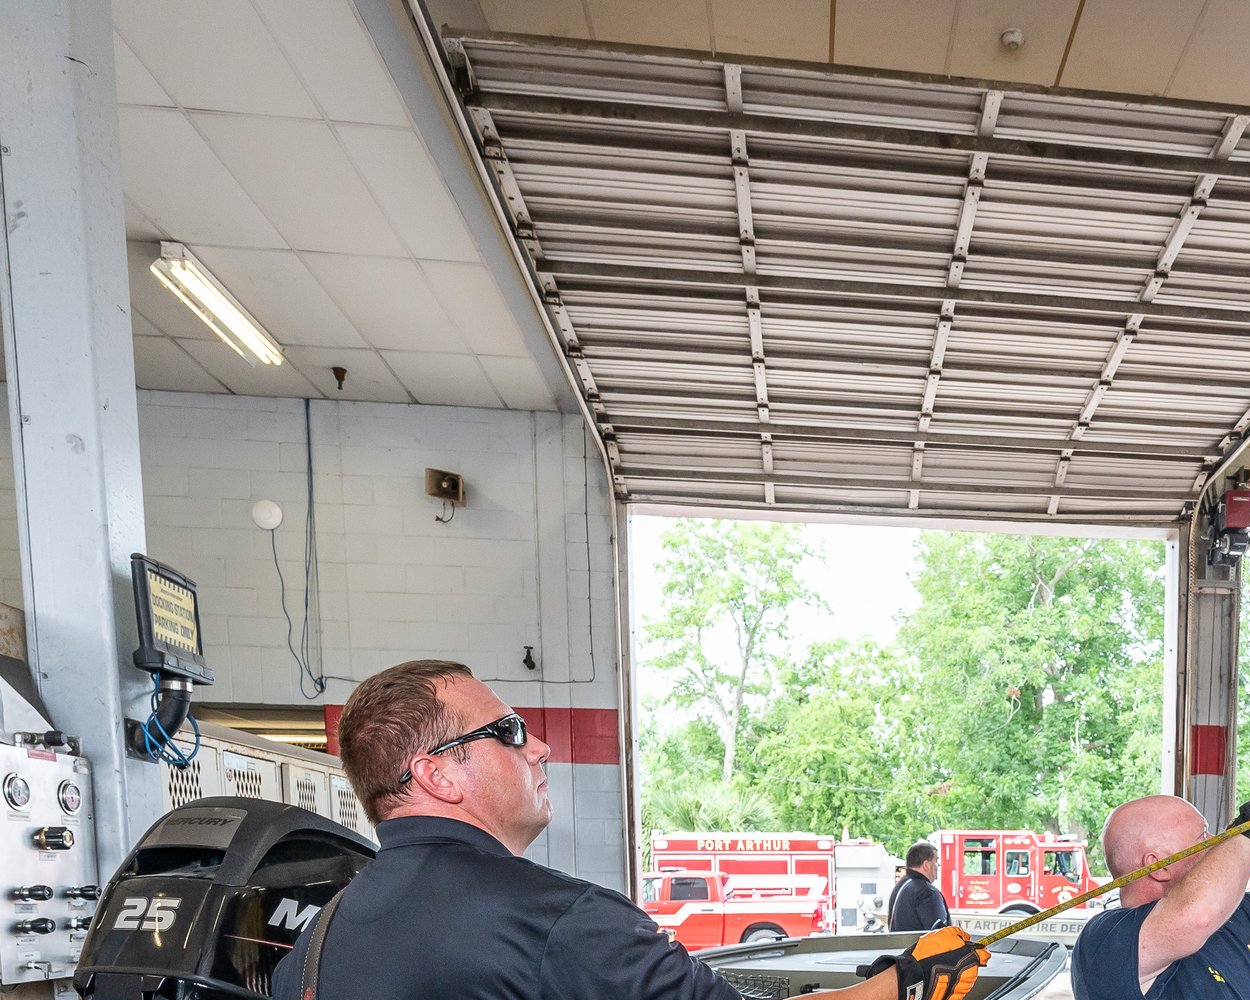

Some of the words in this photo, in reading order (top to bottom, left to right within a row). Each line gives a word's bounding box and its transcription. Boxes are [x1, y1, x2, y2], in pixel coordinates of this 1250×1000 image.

[696, 839, 732, 851] PORT
[736, 839, 791, 851] ARTHUR
[112, 897, 182, 932] 25
[974, 920, 1010, 931] ARTH
[1060, 923, 1083, 934] DEP
